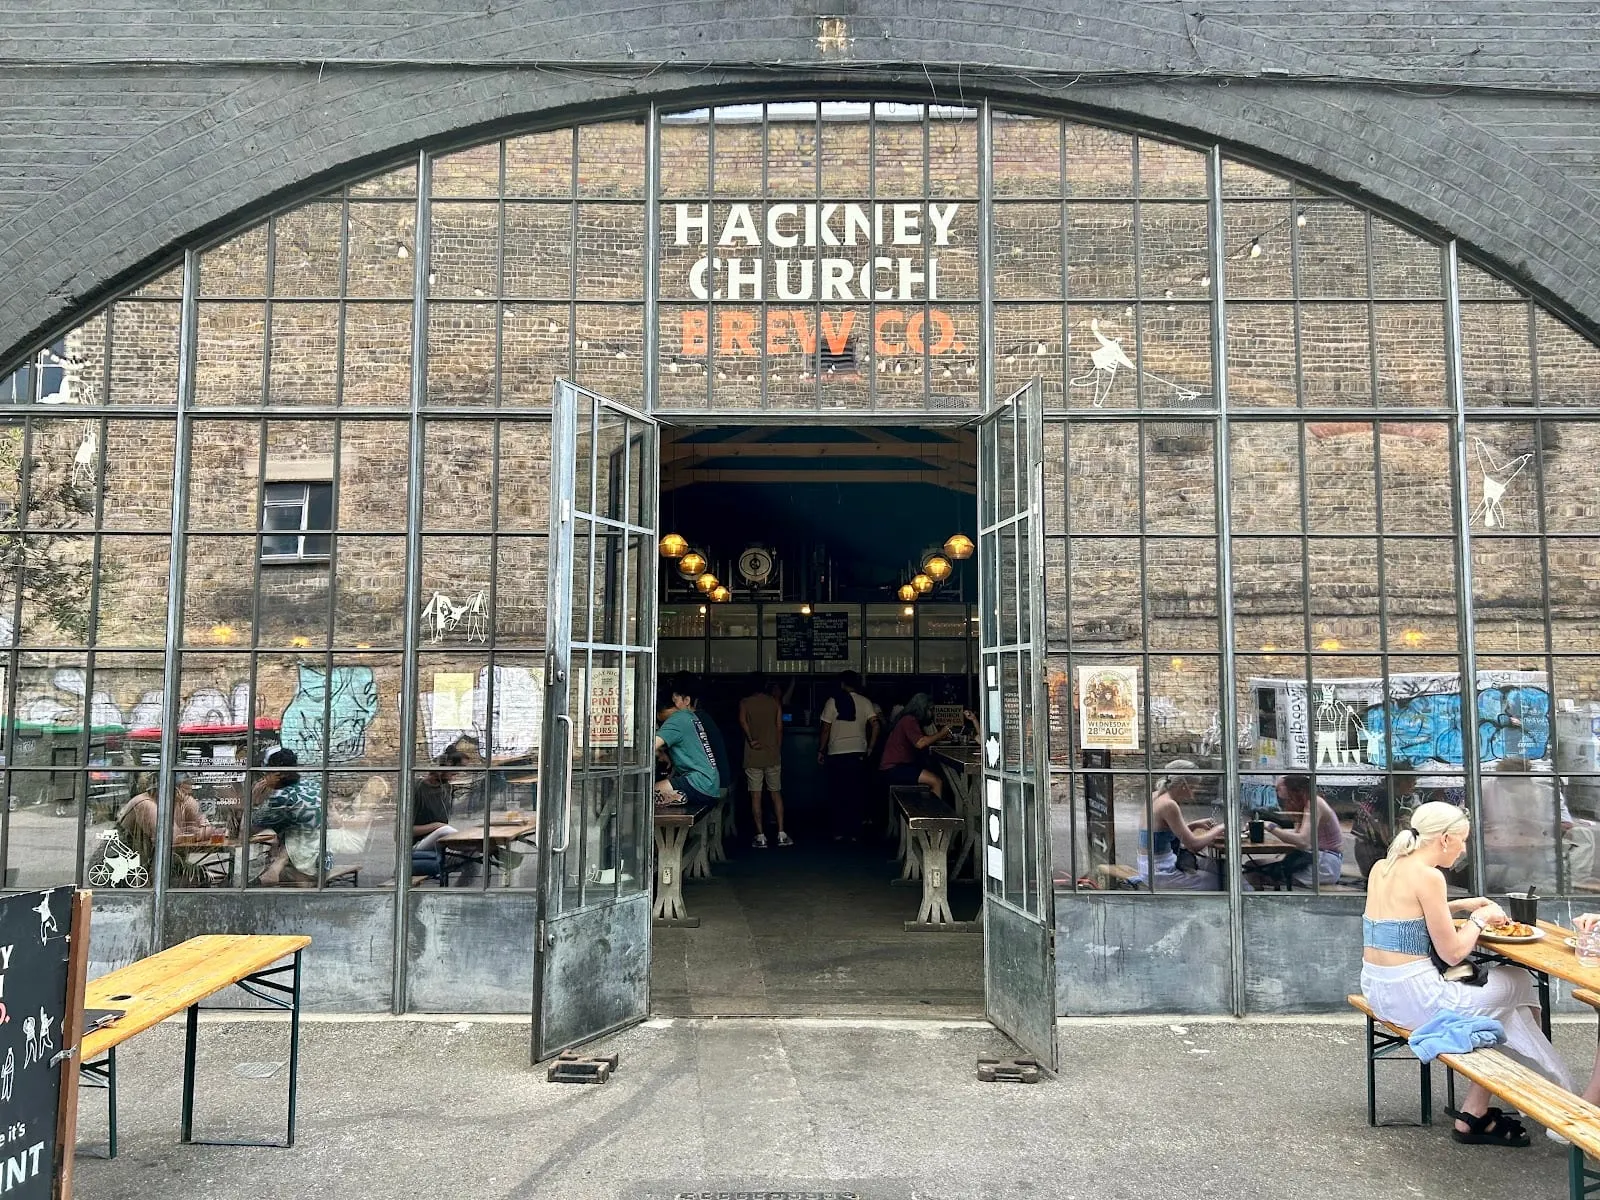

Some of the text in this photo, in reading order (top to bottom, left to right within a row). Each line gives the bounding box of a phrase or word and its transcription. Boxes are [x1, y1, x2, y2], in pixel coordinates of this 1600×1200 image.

[673, 203, 960, 247] HACKNEY
[688, 257, 938, 300] CHURCH
[681, 309, 965, 355] BREW CO.
[592, 697, 618, 706] PINT
[8, 1122, 26, 1142] it's
